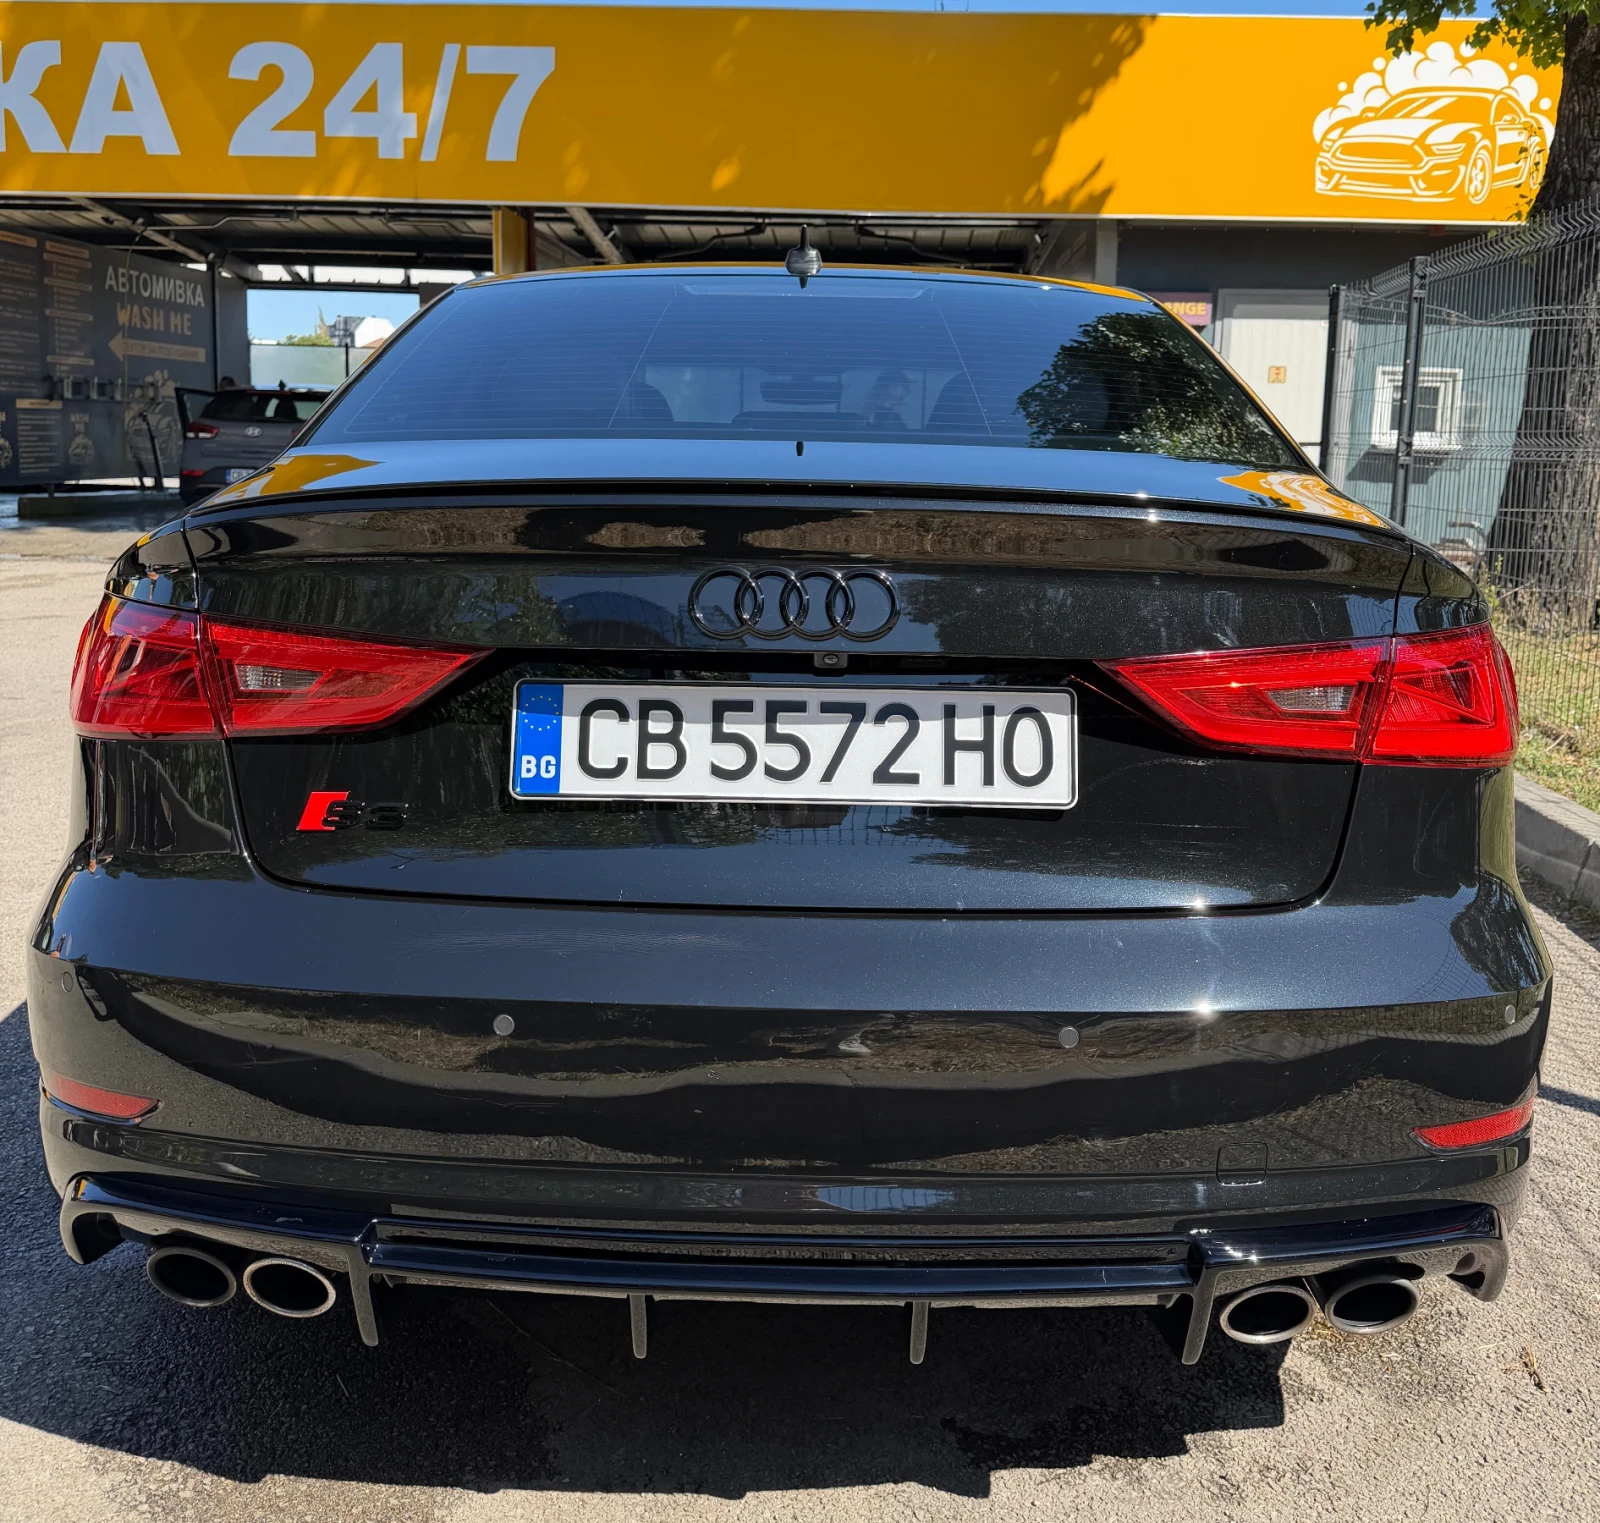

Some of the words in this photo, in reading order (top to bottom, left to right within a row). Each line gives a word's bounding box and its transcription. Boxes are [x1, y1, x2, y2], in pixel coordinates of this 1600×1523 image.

[228, 41, 556, 162] 24/7
[105, 264, 205, 308] АВТОМИВКА
[116, 301, 164, 332] WASH
[169, 309, 192, 336] ME
[578, 698, 687, 780] CB
[710, 699, 920, 785] 5572
[521, 755, 556, 779] BG
